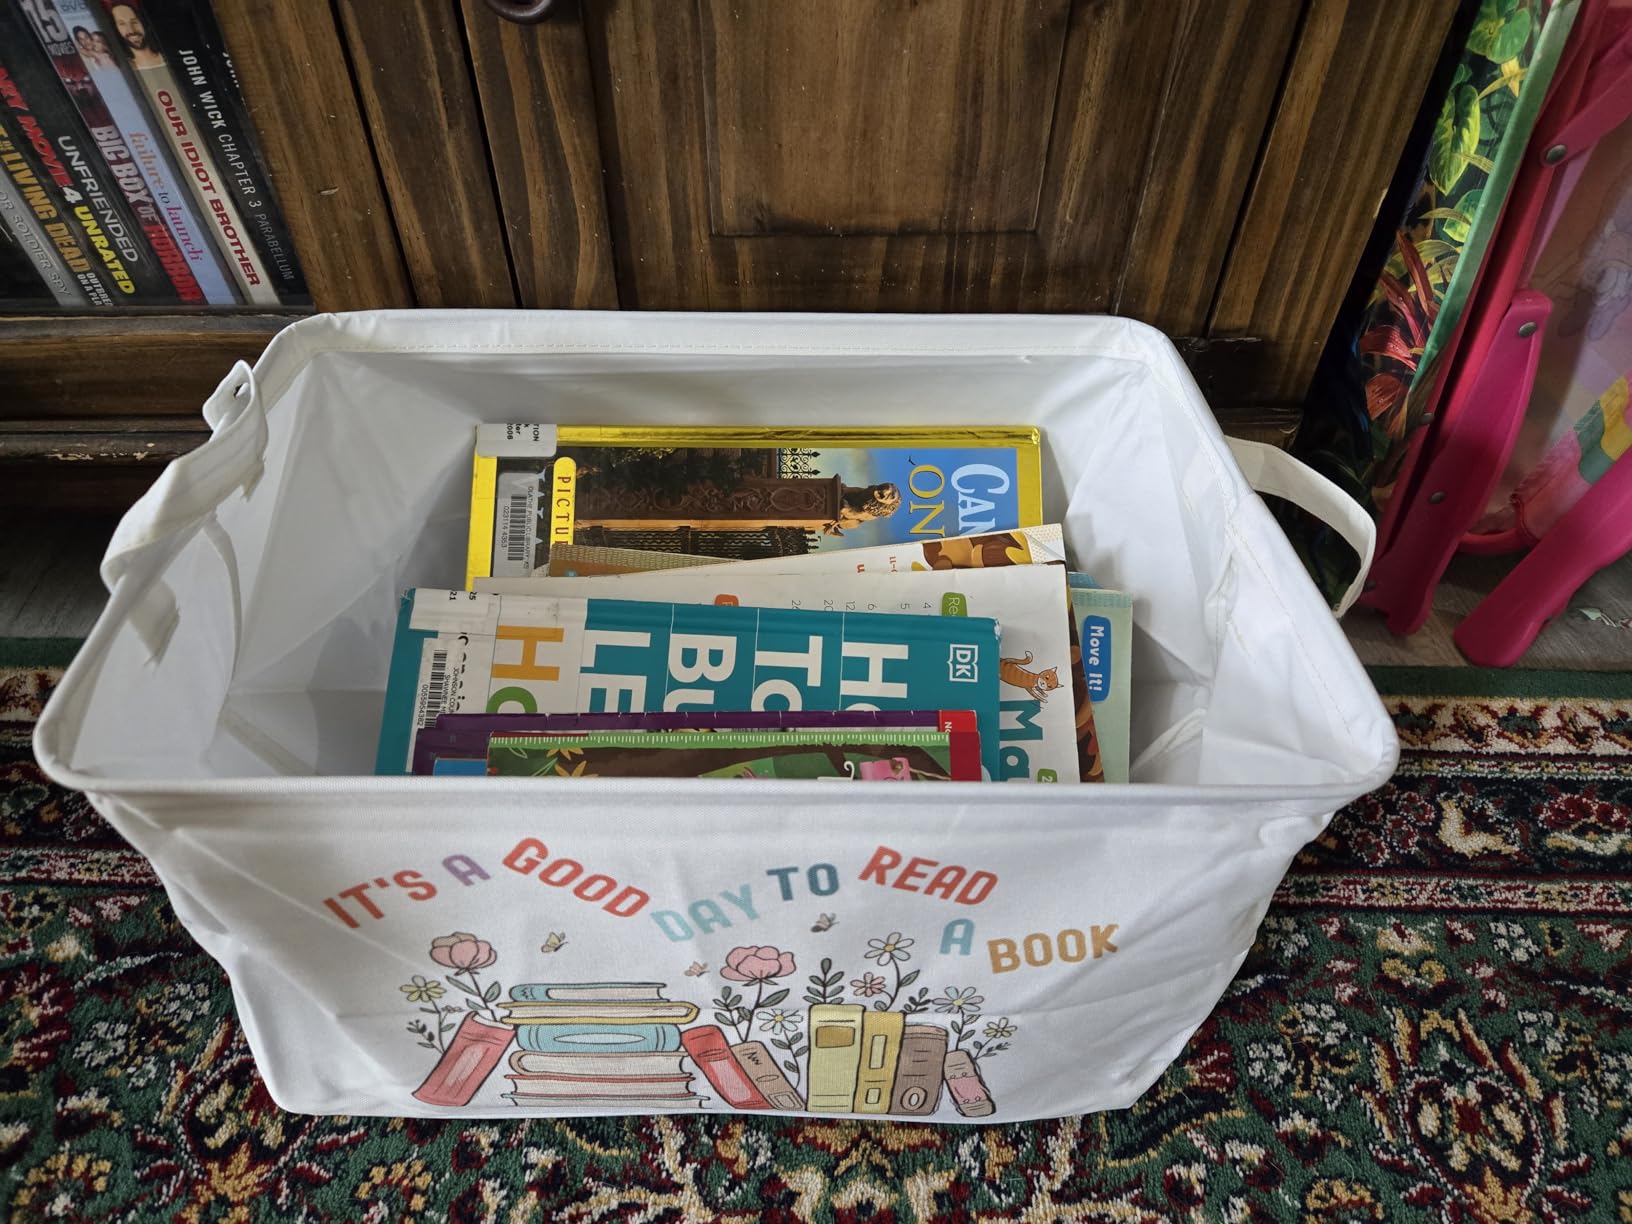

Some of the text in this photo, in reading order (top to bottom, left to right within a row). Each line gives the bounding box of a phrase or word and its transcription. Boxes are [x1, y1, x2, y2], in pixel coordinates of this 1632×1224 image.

[58, 135, 138, 262] UNFRIENDED
[128, 131, 204, 262] failure to launch
[157, 90, 261, 286] OUR IDIOT BROTHER
[179, 49, 295, 280] JOHN WICK CHAPTER 3 PARABELLUM
[1, 152, 91, 273] LIVING DEAD
[17, 116, 75, 187] MOVIE
[62, 187, 83, 203] 4
[74, 206, 136, 294] UNRATED
[91, 125, 204, 303] BIG BOX OF HORROR
[13, 214, 53, 270] SOLDIER
[49, 271, 72, 296] SPY
[525, 510, 533, 532] PUBLIC
[909, 464, 945, 538] ON
[951, 464, 1010, 538] CAN
[845, 600, 855, 611] 12
[867, 603, 877, 611] 6
[948, 597, 961, 617] Re
[441, 675, 451, 705] SHAWNEE
[450, 667, 459, 696] JOHNSON
[840, 642, 908, 711] H
[955, 651, 971, 678] DK
[1088, 625, 1105, 692] Move It!
[323, 837, 999, 943] IT'S A GOOD DAY TO READ
[939, 918, 1120, 975] A BOOK
